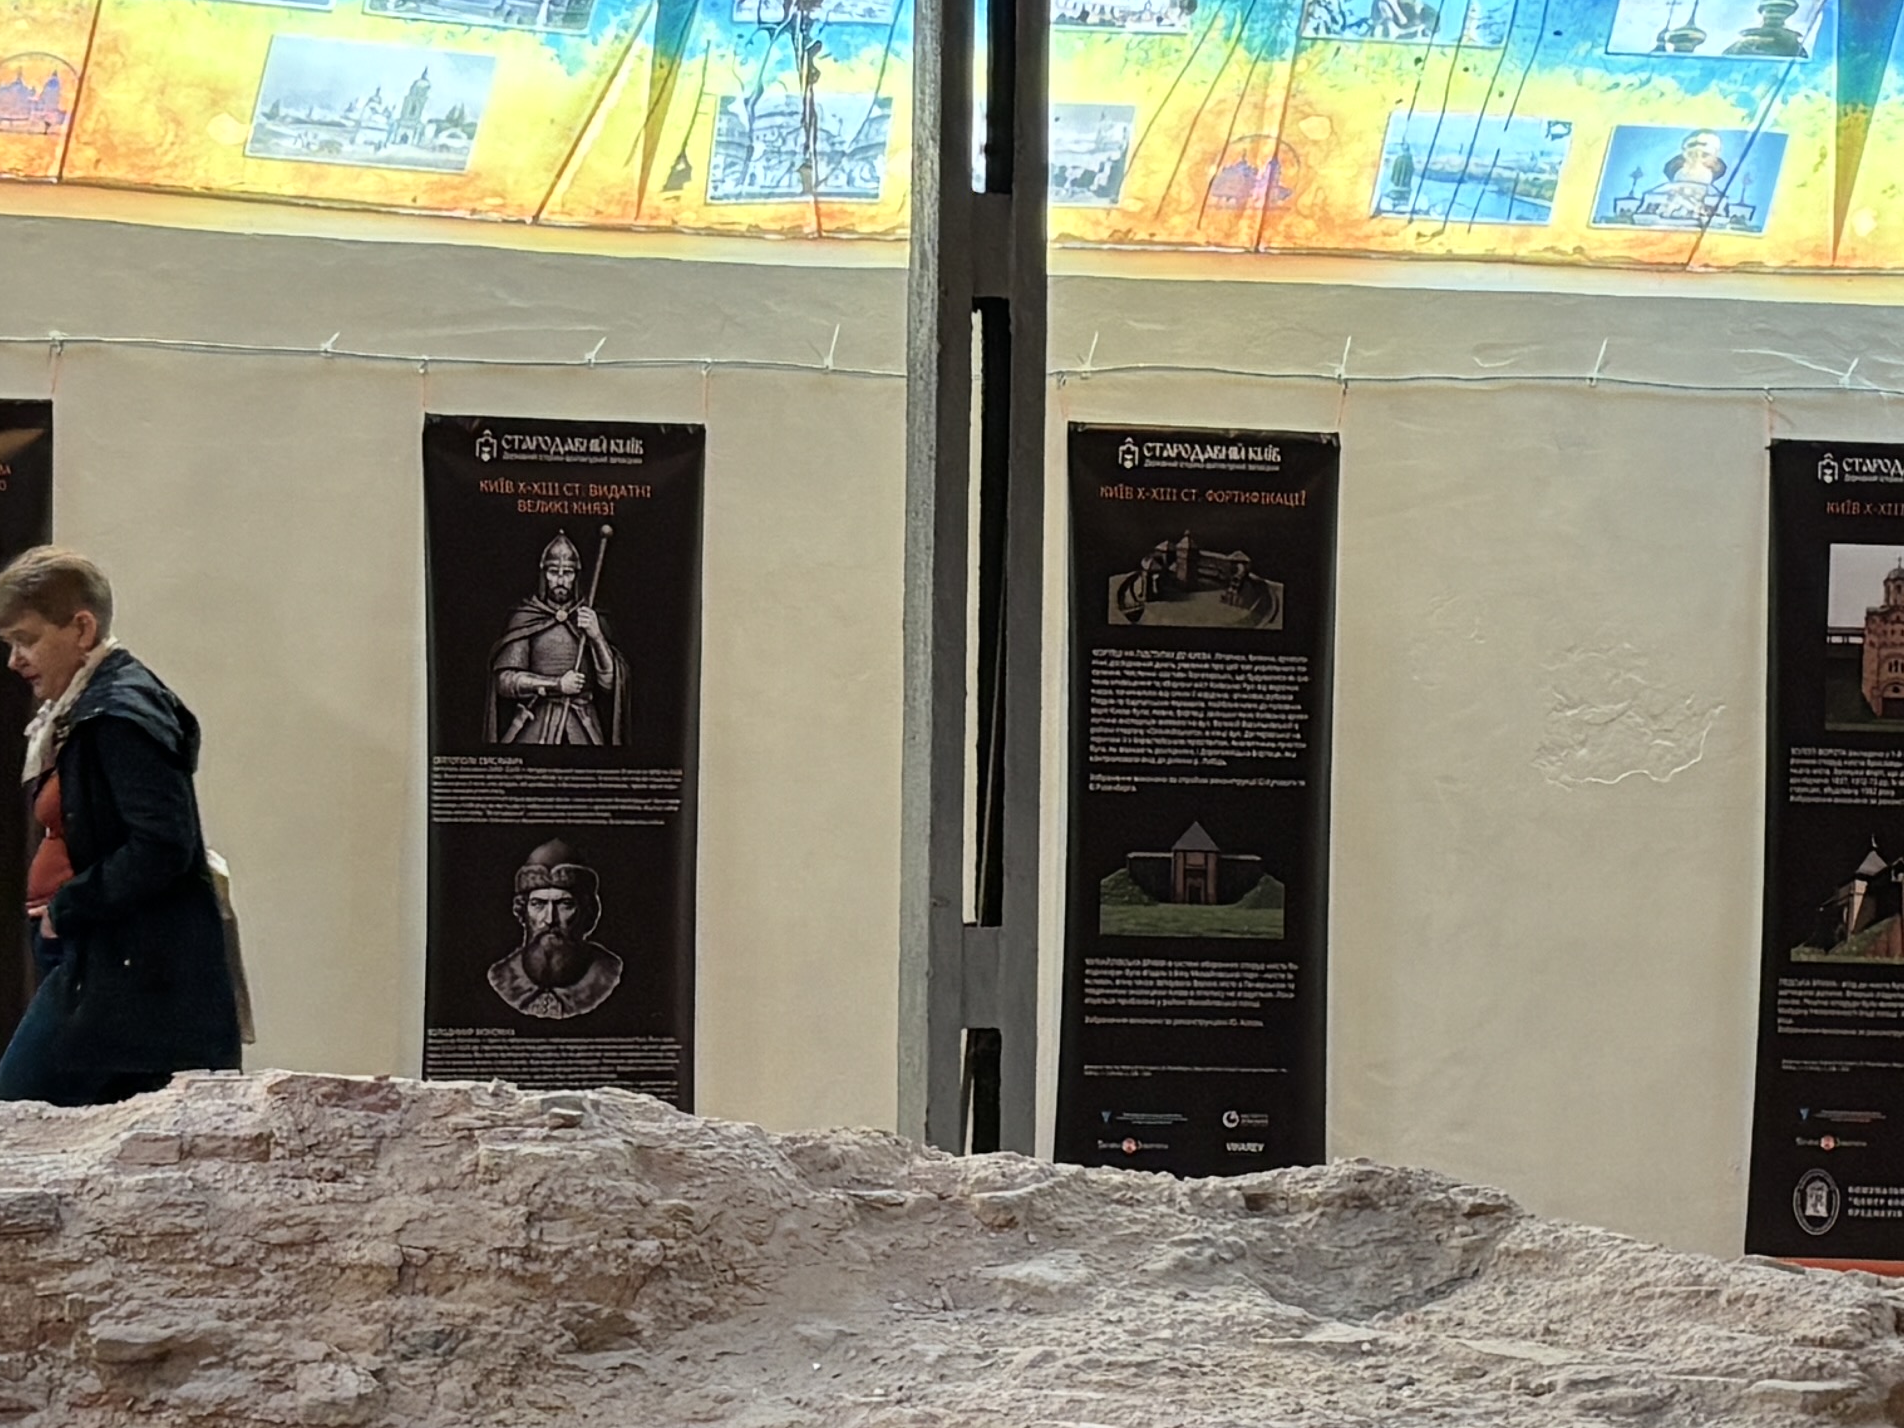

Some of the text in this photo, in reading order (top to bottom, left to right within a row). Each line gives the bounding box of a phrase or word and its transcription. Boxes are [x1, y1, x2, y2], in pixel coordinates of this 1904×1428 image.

[501, 434, 645, 455] СТАРОДАВНІЙ КИЇВ
[1143, 442, 1282, 463] СТАРОДАВНІЙ КИЇВ
[479, 477, 514, 494] КИЇВ
[588, 483, 652, 500] ВИДАТНІ
[1099, 484, 1134, 500] КИЇВ
[1205, 489, 1307, 507] ФОРТИФІКАЦІЇ
[517, 499, 615, 516] ВЕЛИКІ КНЯЗІ
[1826, 499, 1861, 515] КИЇВ
